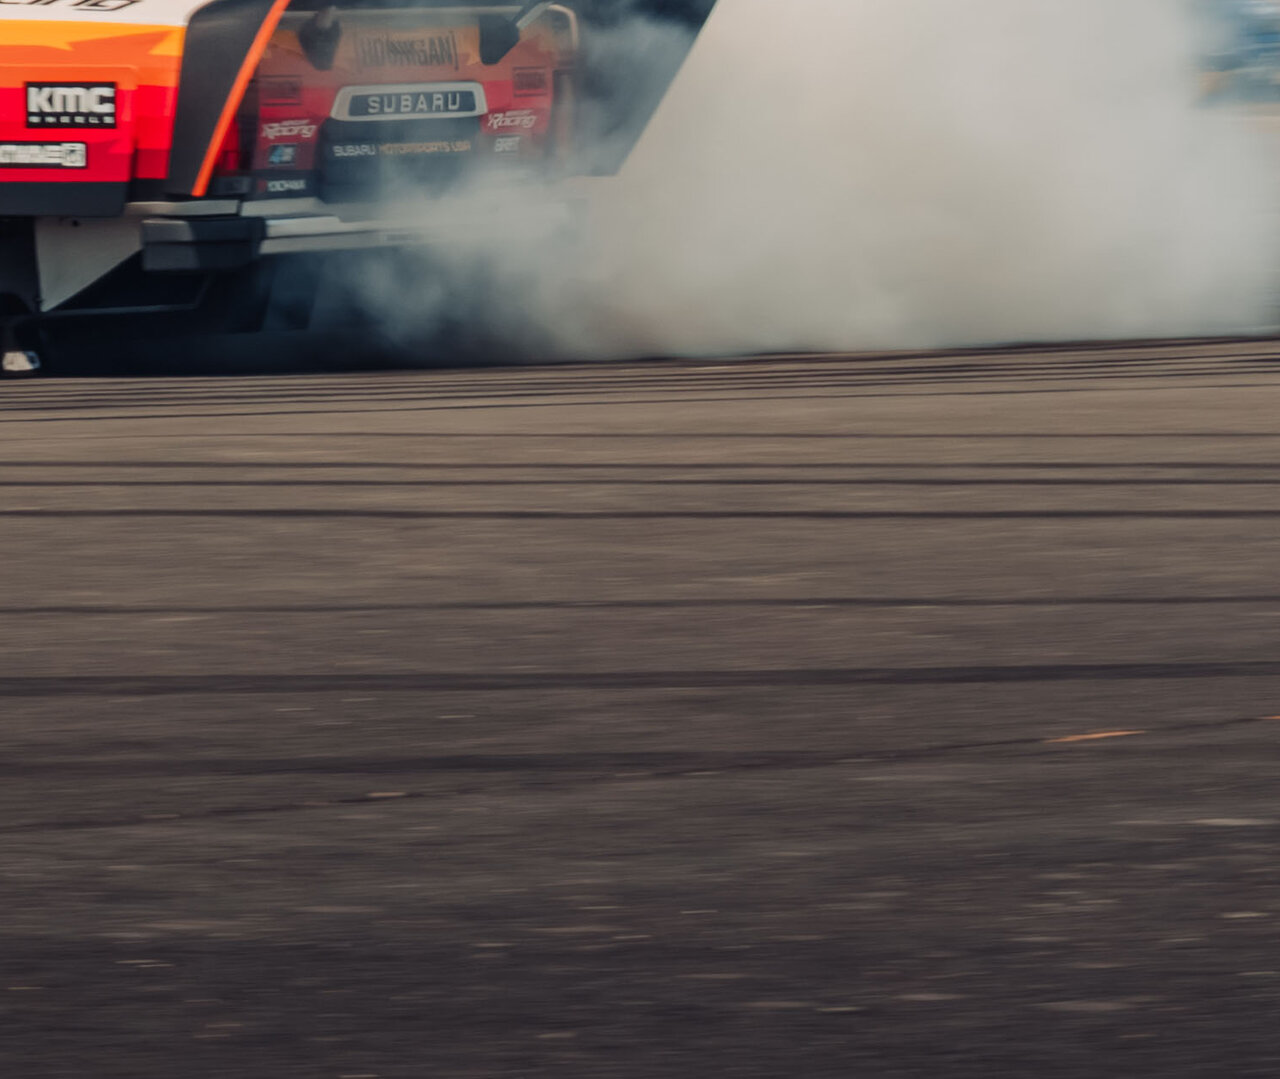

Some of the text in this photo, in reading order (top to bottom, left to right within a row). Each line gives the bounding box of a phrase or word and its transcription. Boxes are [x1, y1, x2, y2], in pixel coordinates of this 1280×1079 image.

[27, 87, 116, 113] KMC
[367, 93, 460, 114] SUBARU
[332, 144, 377, 157] SUBARU
